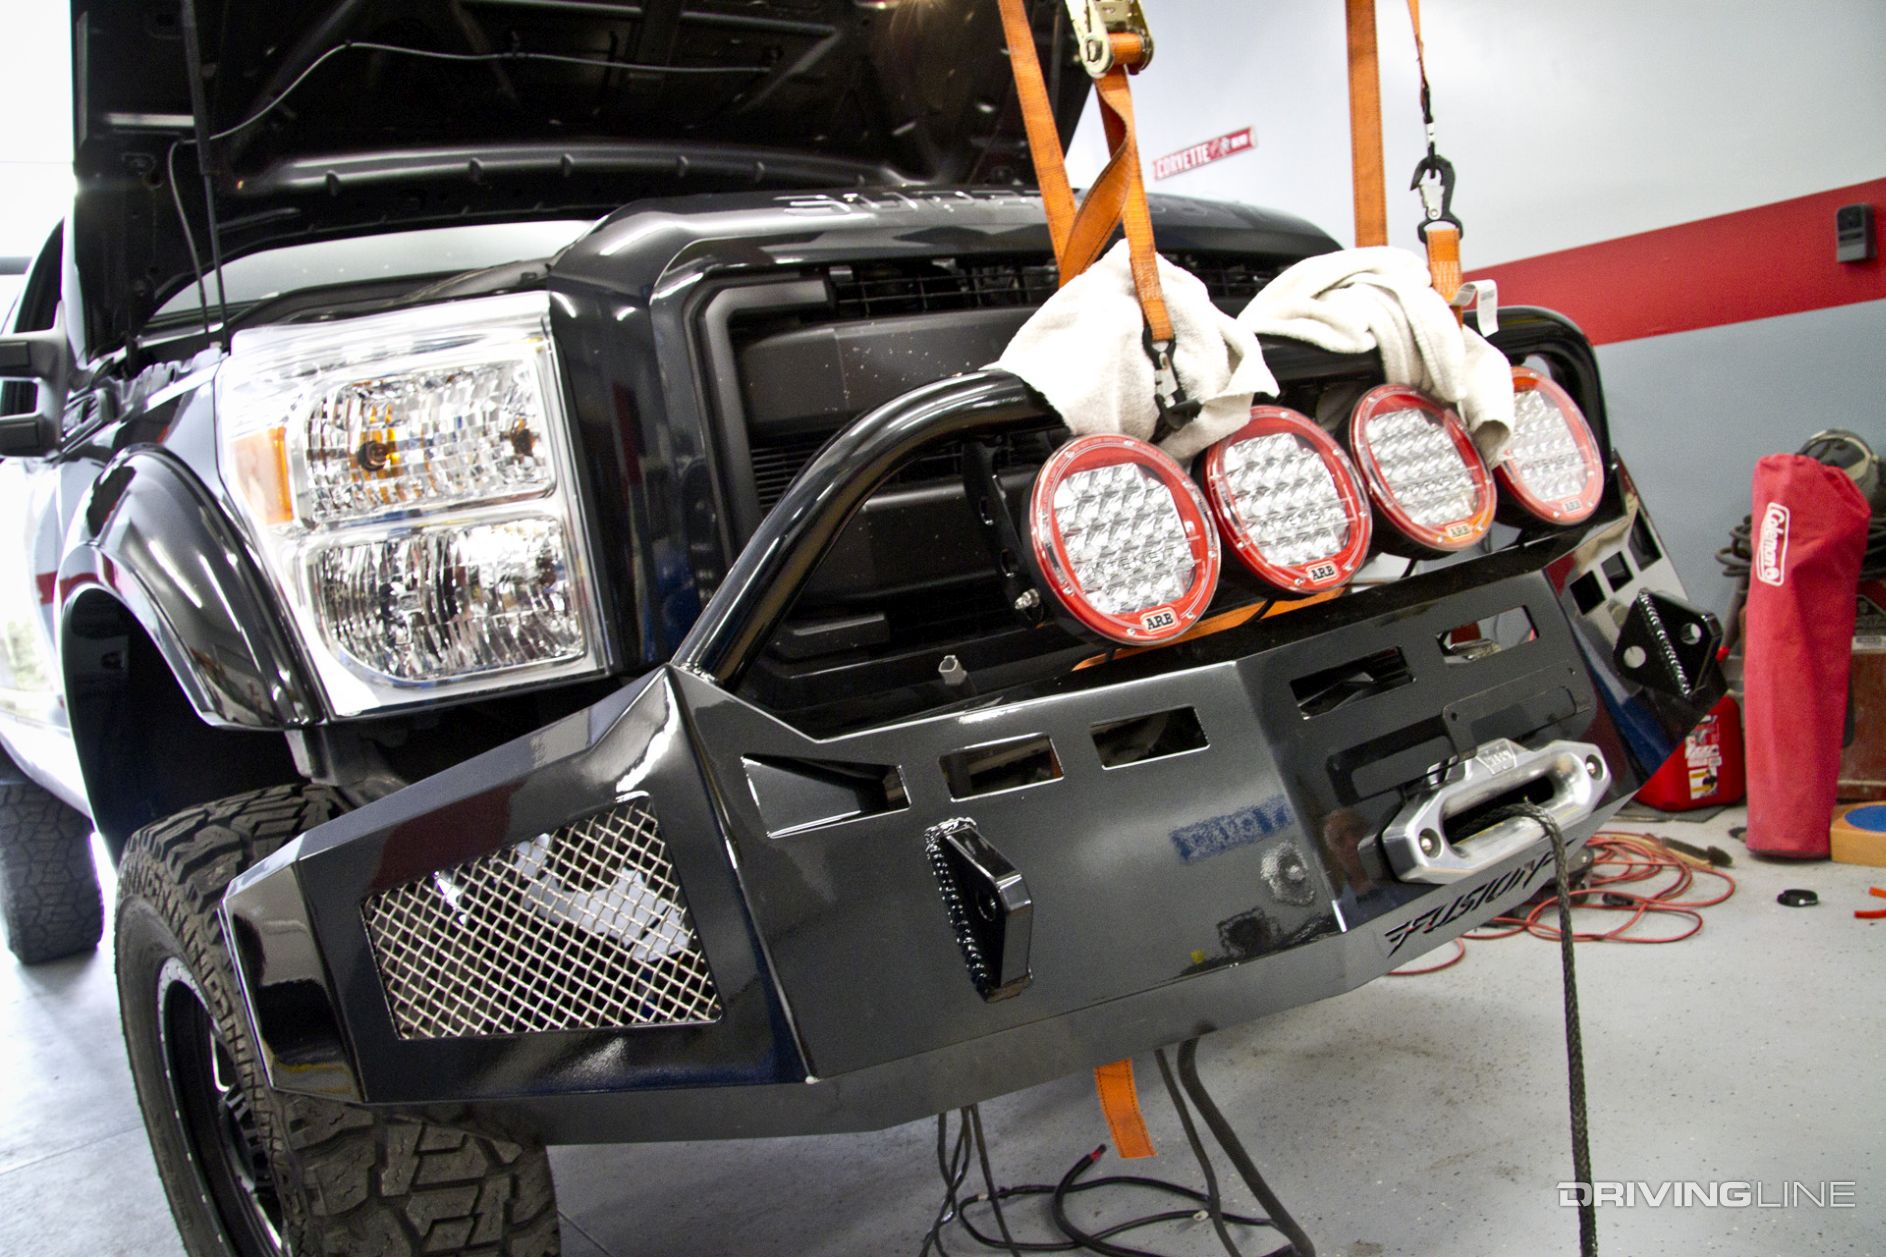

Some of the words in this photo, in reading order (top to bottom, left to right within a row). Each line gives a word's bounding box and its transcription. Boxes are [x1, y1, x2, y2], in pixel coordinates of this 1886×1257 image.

[1762, 508, 1785, 567] Coleman
[1310, 565, 1335, 580] ARB
[1145, 612, 1174, 630] ARB
